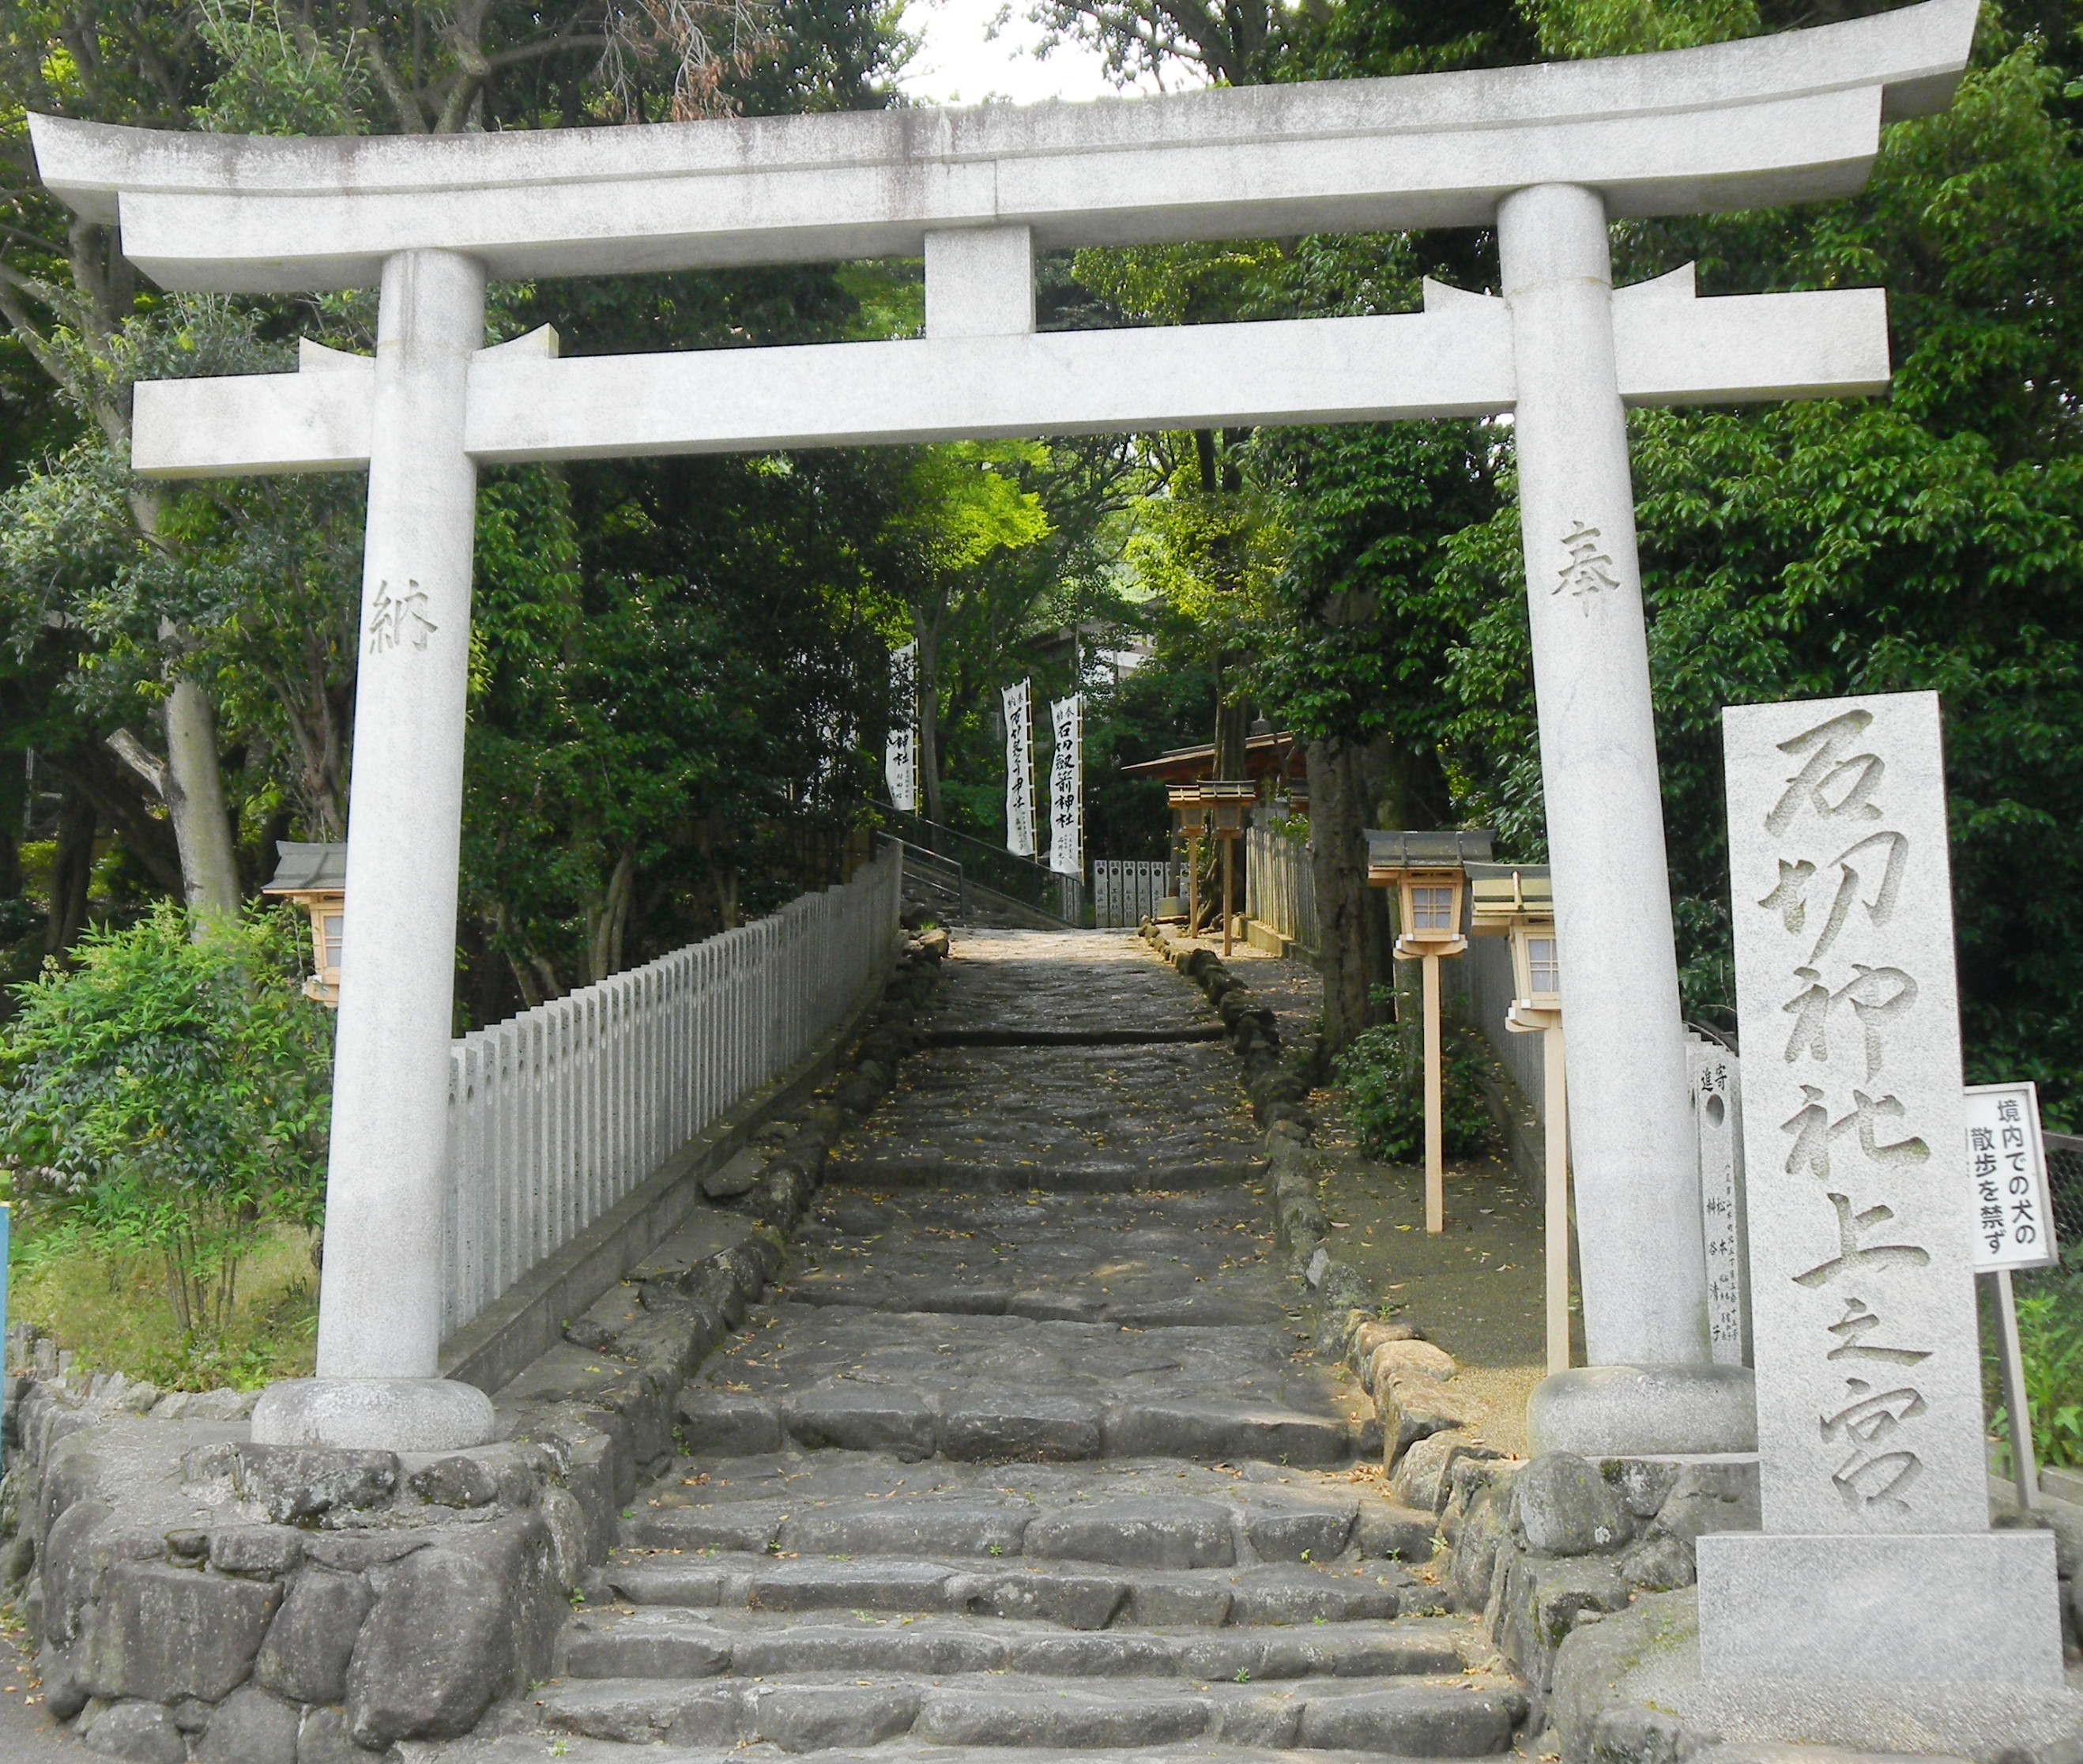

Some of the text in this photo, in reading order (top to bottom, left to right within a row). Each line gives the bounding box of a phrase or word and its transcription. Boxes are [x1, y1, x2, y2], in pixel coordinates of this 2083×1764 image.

[369, 578, 439, 654] 納
[1551, 519, 1621, 618] 奉
[1701, 1063, 1727, 1092] 寄進
[1758, 709, 1933, 1513] 石切神社上之宮
[1970, 1126, 2006, 1255] 散歩を禁ず
[1998, 1099, 2036, 1245] 境内での犬の
